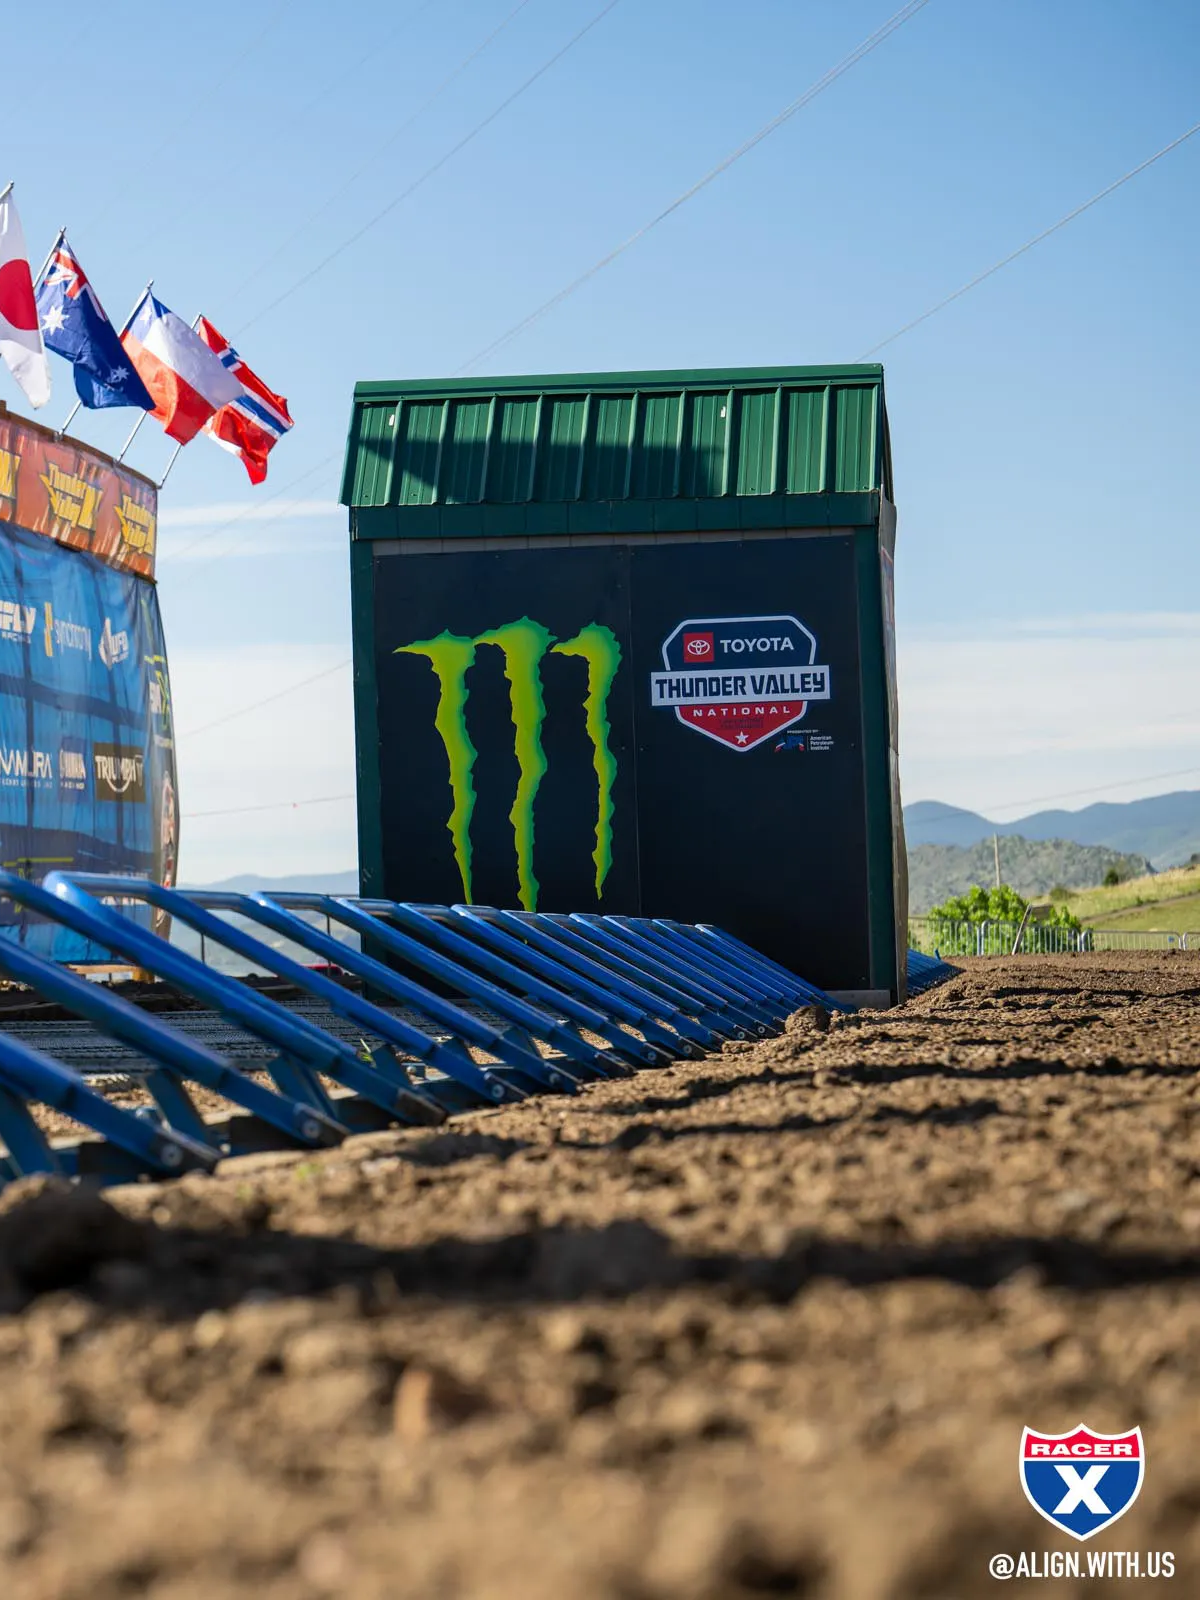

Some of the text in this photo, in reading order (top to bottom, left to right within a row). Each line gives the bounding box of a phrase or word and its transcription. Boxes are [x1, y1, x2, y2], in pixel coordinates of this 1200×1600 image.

[719, 637, 794, 653] TOYOTA
[655, 672, 825, 698] THUNDER VALLEY
[693, 706, 791, 717] NATIONAL
